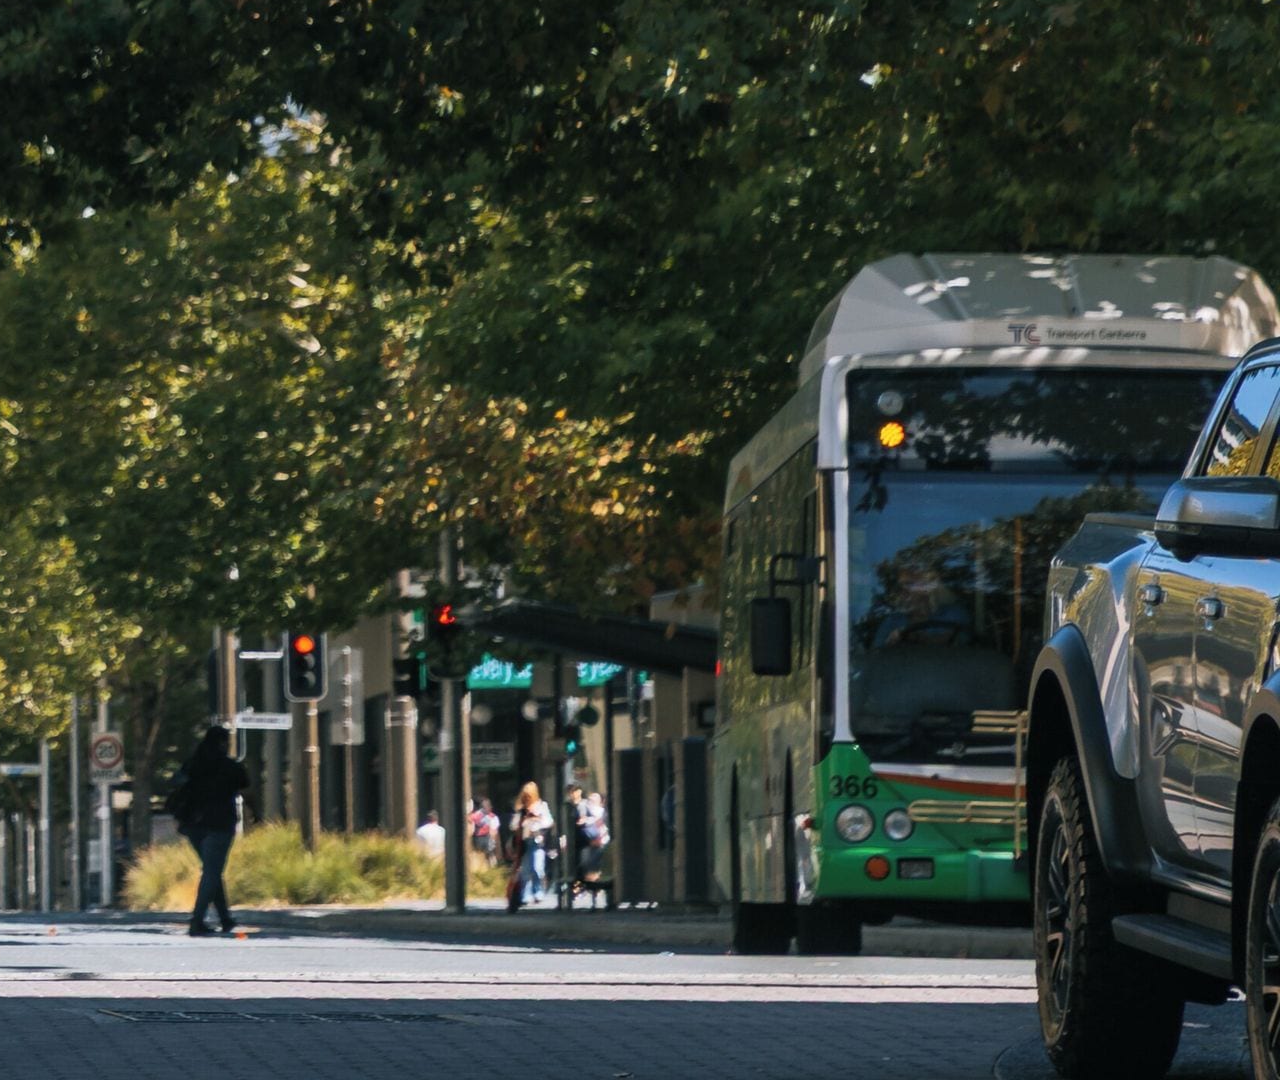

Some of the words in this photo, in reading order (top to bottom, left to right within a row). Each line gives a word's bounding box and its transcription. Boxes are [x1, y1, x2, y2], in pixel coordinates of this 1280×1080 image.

[1008, 323, 1041, 345] TC
[1046, 327, 1095, 341] Transport
[1098, 327, 1147, 340] Canberra
[830, 774, 879, 799] 366
